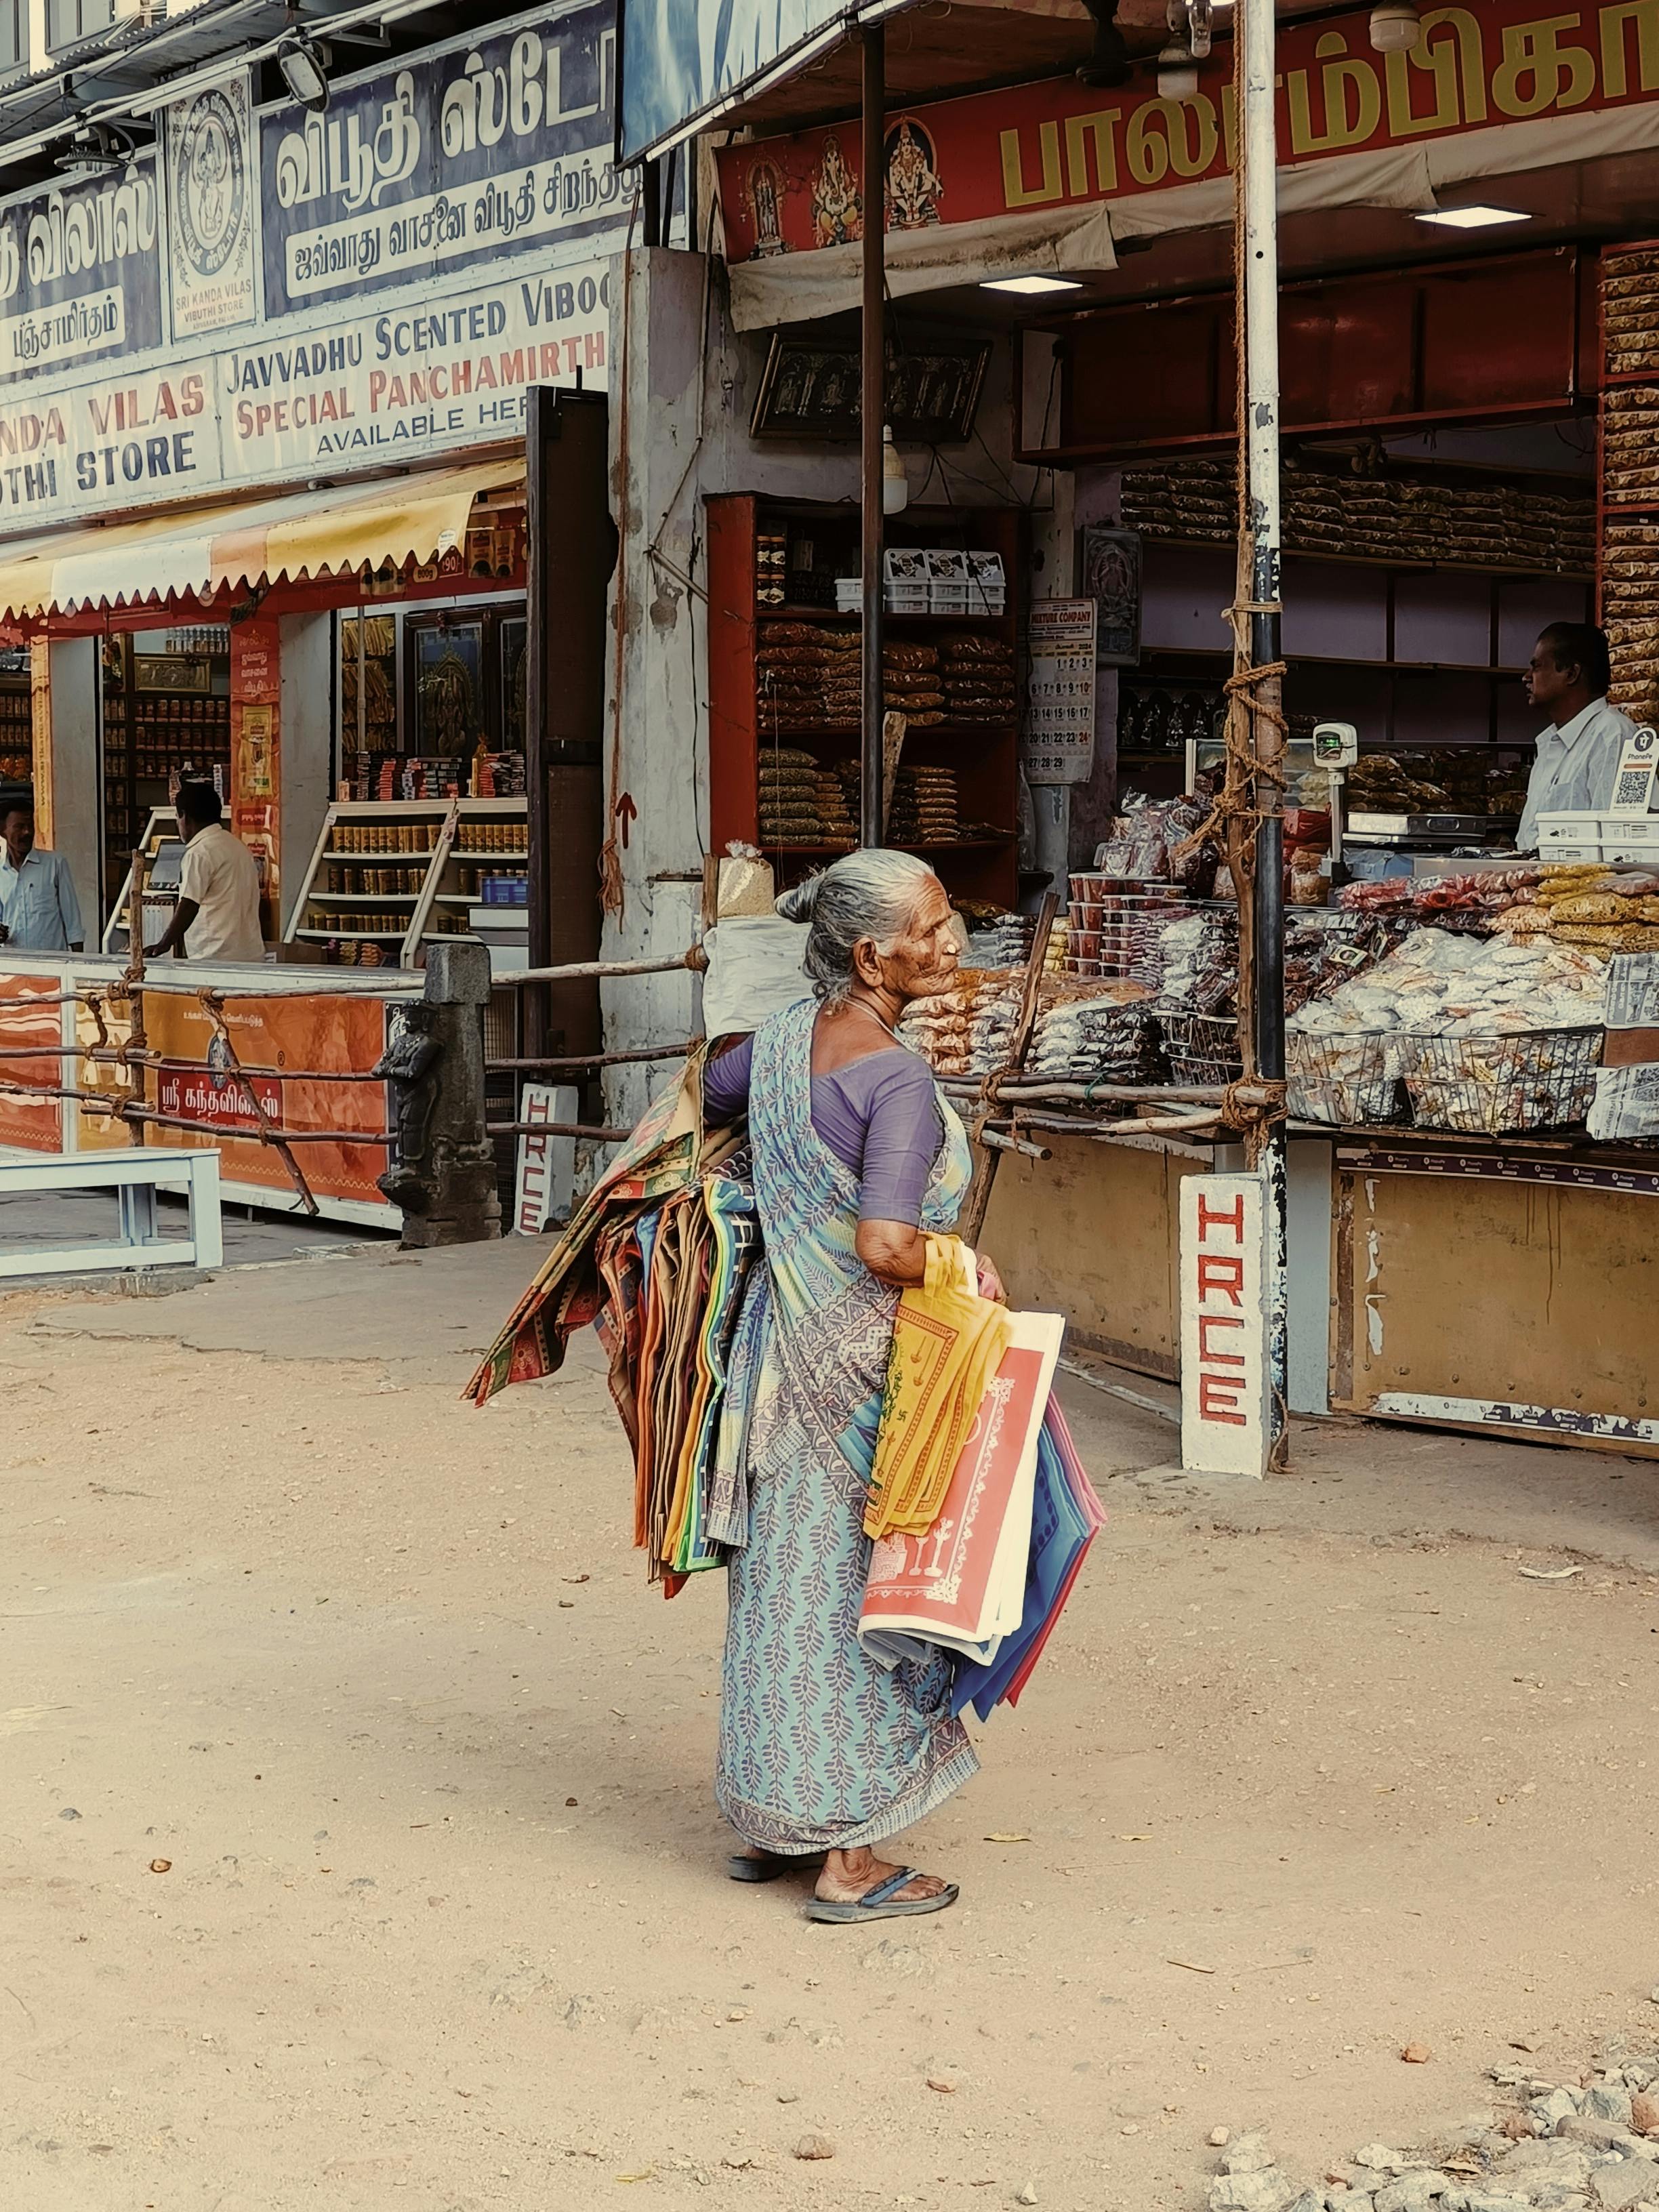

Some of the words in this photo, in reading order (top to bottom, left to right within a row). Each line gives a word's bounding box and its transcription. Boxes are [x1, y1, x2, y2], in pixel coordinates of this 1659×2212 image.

[276, 70, 420, 213] விபூதி
[441, 30, 616, 158] ஸ்டோ
[28, 164, 156, 285] விலாஸ்
[295, 226, 380, 281] ஜவ்வாது
[389, 197, 467, 258] வாசனை
[474, 170, 535, 236] விபூதி
[176, 295, 189, 311] SRI
[192, 287, 222, 306] KANDA
[225, 279, 251, 297] VILAS
[184, 306, 216, 323] VIBUTHI
[218, 299, 244, 314] STORE
[14, 295, 117, 360] பஞ்சாமிர்தம்
[226, 333, 362, 395] JAVVADHU
[375, 300, 506, 361] SCENTED
[87, 374, 204, 435] VILAS
[237, 386, 355, 441] SPECIAL
[370, 331, 605, 413] PANCHAMIRTH
[316, 407, 464, 456] AVAILABLE
[0, 459, 57, 505] THI
[76, 430, 196, 491] STORE
[1031, 613, 1057, 624] MIXTURE
[1059, 611, 1090, 623] COMPANY
[1031, 684, 1036, 694] 6
[1044, 684, 1048, 693] 7
[1057, 683, 1061, 693] 8
[1069, 682, 1073, 693] 9
[1080, 682, 1088, 693] 10
[1057, 659, 1061, 668] 1
[1069, 658, 1074, 668] 2
[1082, 657, 1086, 668] 3
[1029, 733, 1038, 743] 20
[1042, 733, 1050, 743] 21
[1054, 733, 1062, 743] 22
[1067, 732, 1075, 742] 23
[1079, 732, 1088, 742] 24
[1030, 708, 1038, 718] 13
[1042, 708, 1050, 718] 14
[1054, 708, 1062, 718] 15
[1067, 707, 1075, 717] 16
[1080, 707, 1088, 717] 17
[1029, 758, 1038, 767] 27
[1042, 758, 1050, 767] 28
[1054, 757, 1062, 767] 29
[185, 1081, 278, 1118] கந்தவிலஸ்
[520, 1094, 550, 1233] HRCE
[1198, 1193, 1246, 1426] HRCE
